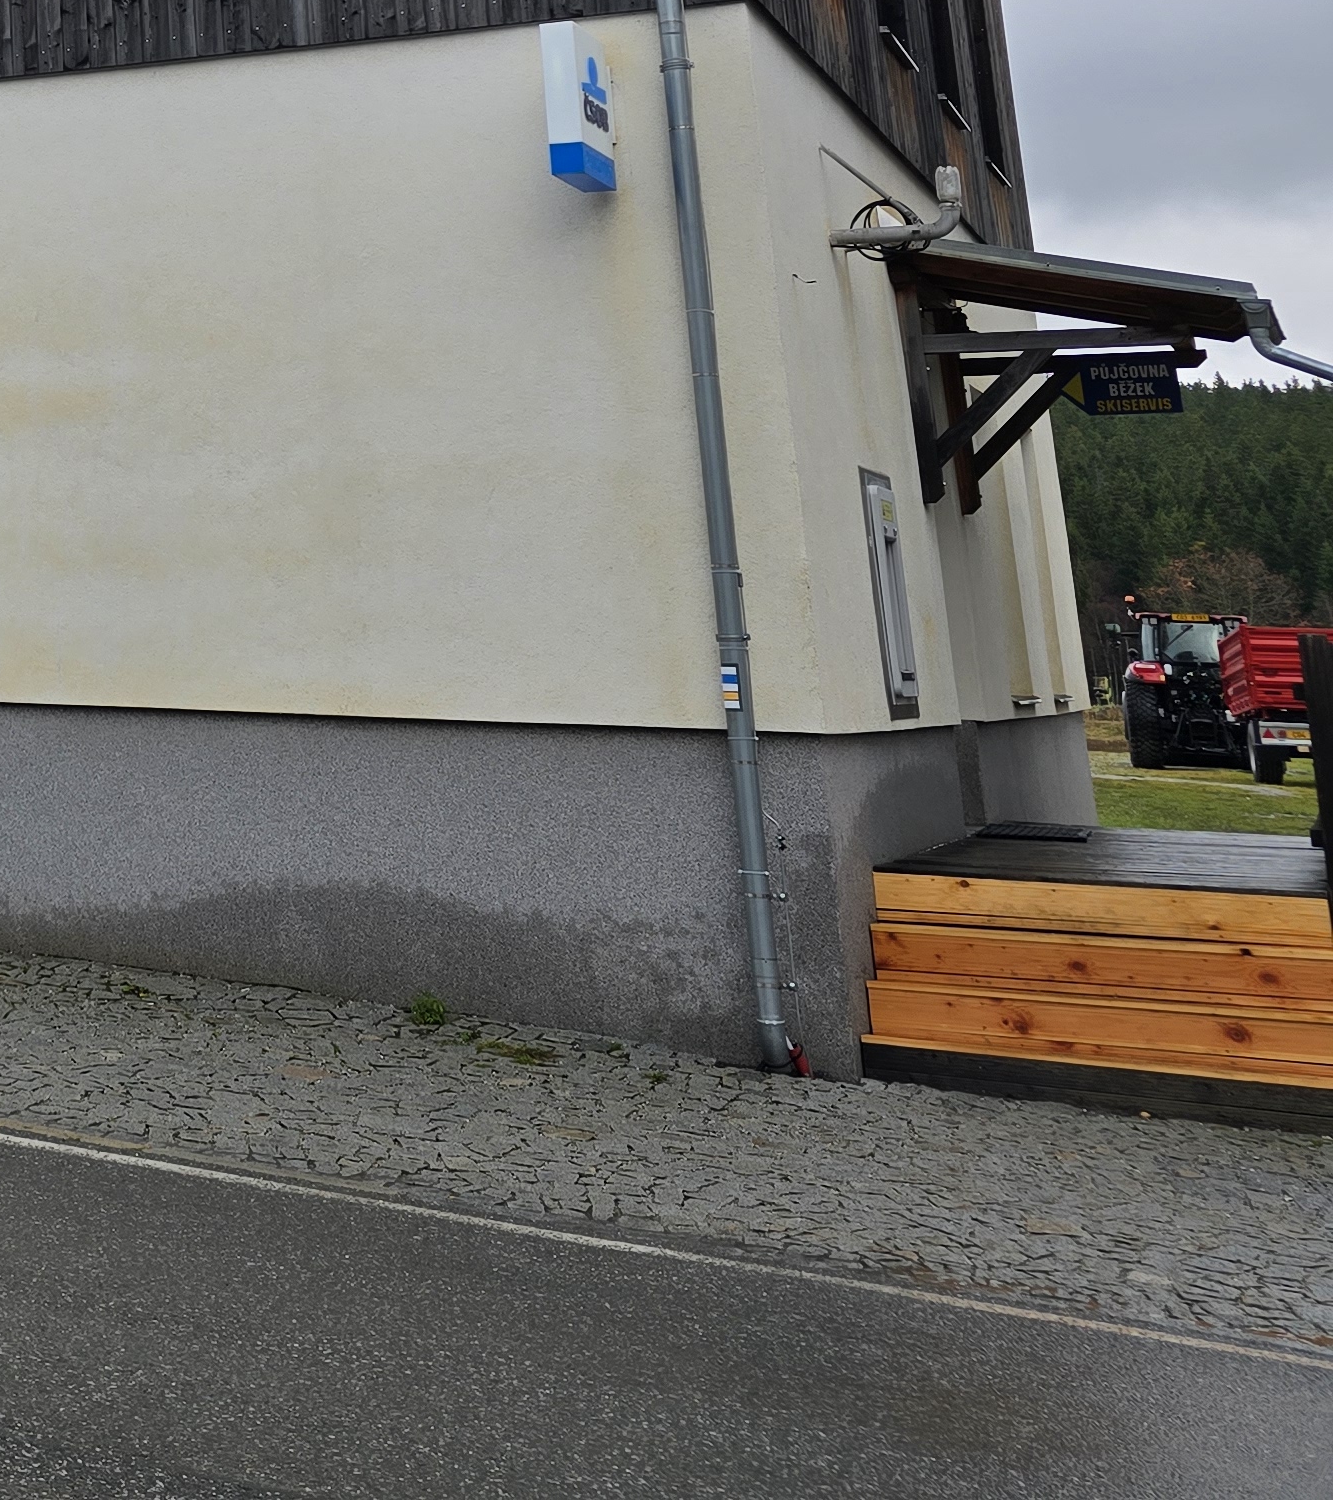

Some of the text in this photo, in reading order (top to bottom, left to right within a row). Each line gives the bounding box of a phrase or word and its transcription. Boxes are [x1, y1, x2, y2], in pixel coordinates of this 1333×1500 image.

[1090, 362, 1169, 380] PŮJČOVNA
[1108, 380, 1155, 397] BĚŽEK
[1096, 398, 1173, 413] SKISERVIS
